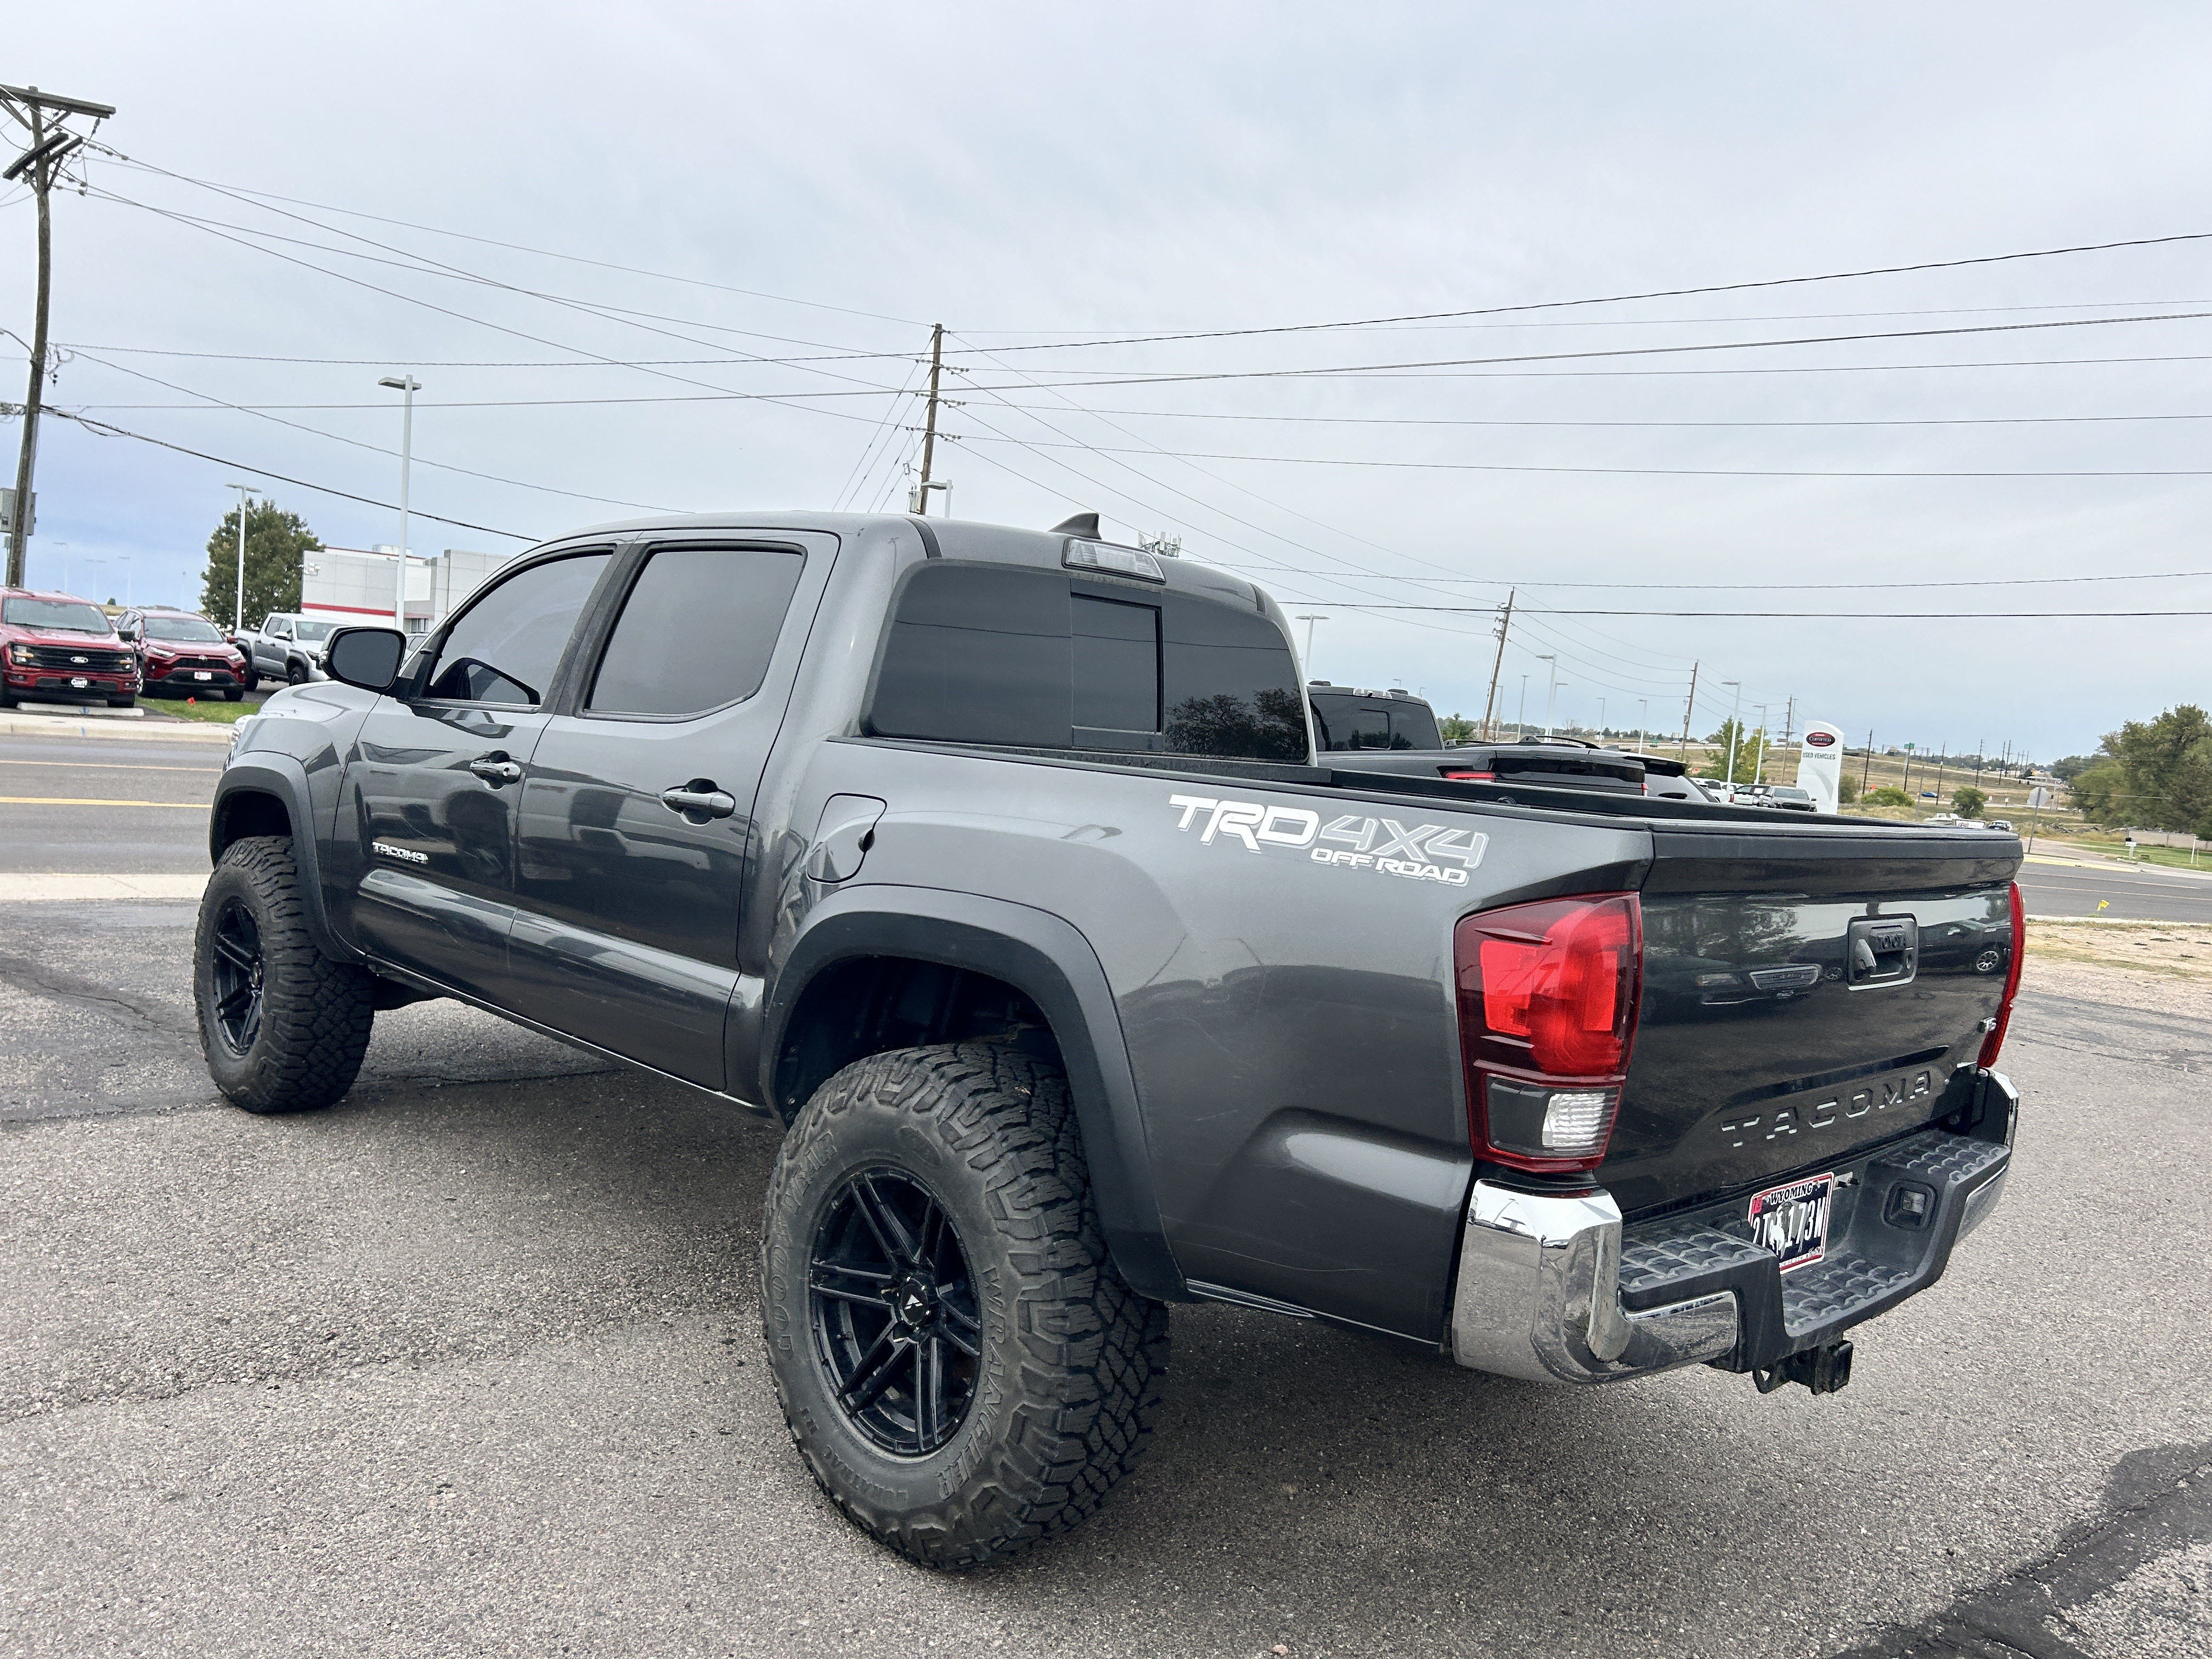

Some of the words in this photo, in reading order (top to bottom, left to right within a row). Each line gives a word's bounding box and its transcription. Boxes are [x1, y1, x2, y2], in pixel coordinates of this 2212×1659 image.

[1169, 794, 1320, 853] TRD
[372, 842, 429, 865] TACOMA
[1310, 847, 1373, 870] OFF
[1375, 859, 1470, 887] ROAD
[1720, 1070, 1931, 1148] TACOMA
[1770, 1183, 1814, 1205] WYOMING
[936, 1267, 1006, 1500] WRANGLER
